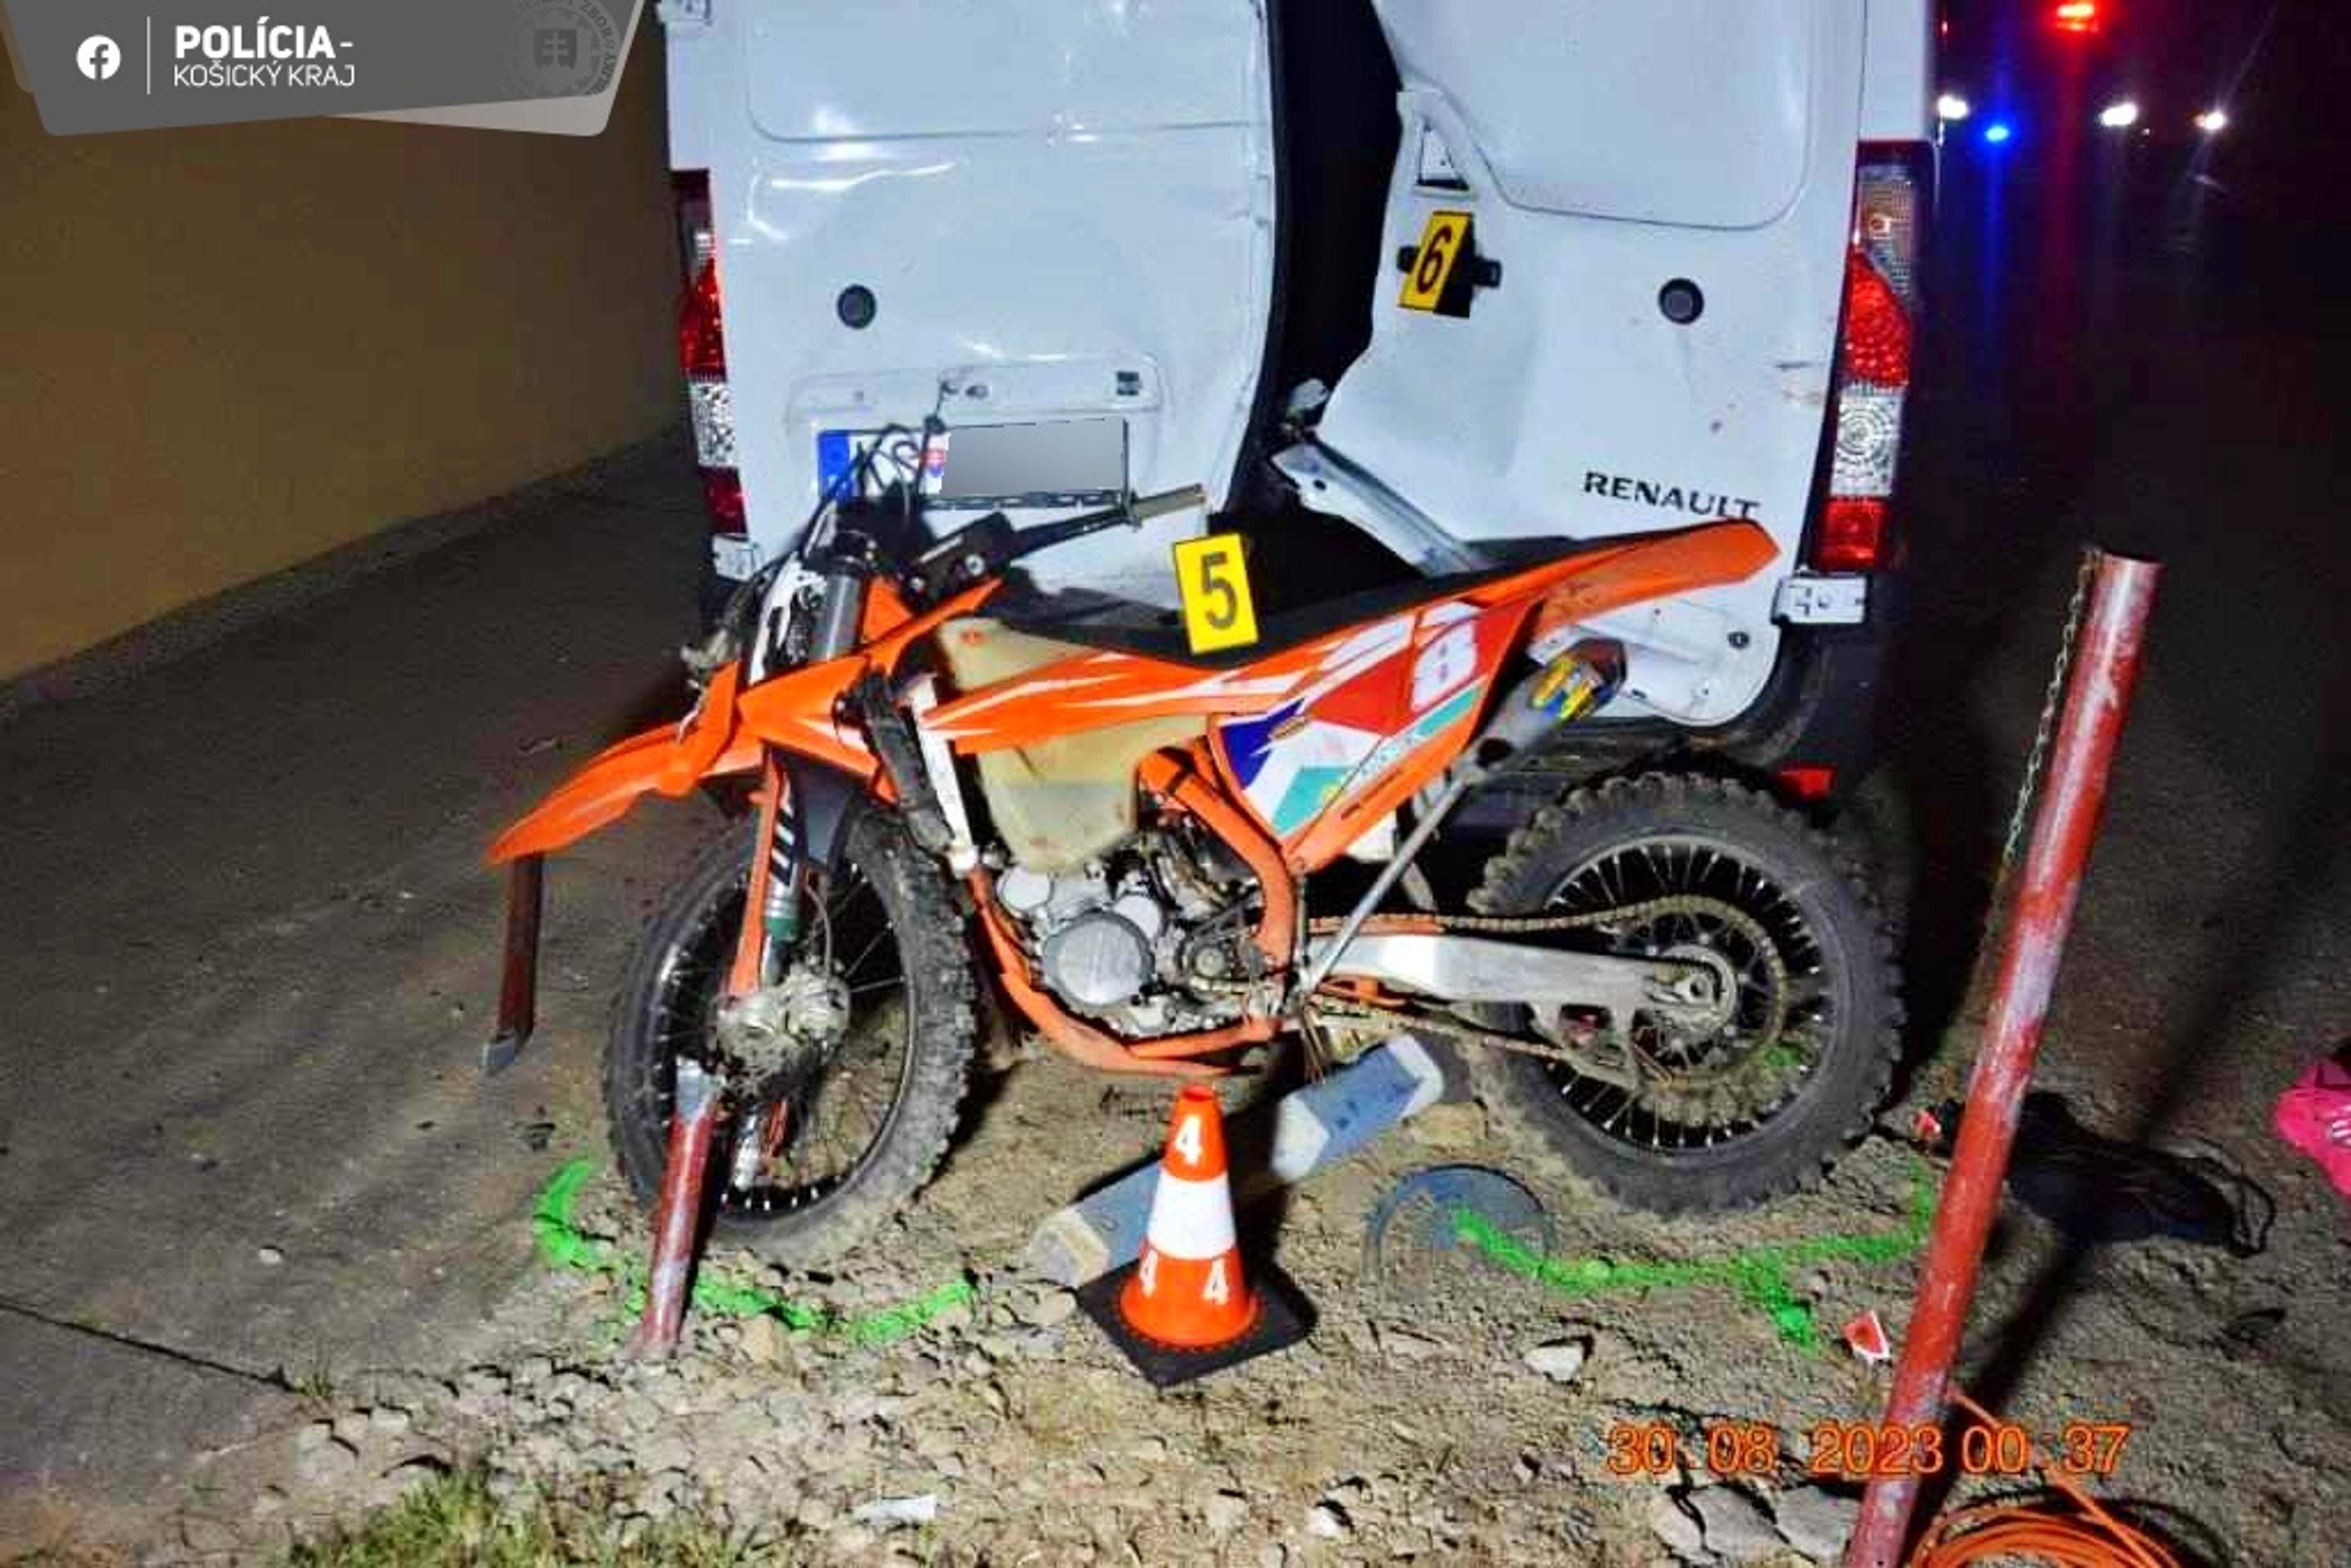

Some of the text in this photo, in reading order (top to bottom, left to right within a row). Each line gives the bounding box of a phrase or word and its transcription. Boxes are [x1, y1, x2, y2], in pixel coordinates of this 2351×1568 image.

[1417, 224, 1453, 295] 6
[1583, 470, 1761, 519] RENAULT
[1200, 550, 1238, 630] 5
[1174, 1113, 1203, 1166] 4
[1138, 1248, 1229, 1306] 4 4
